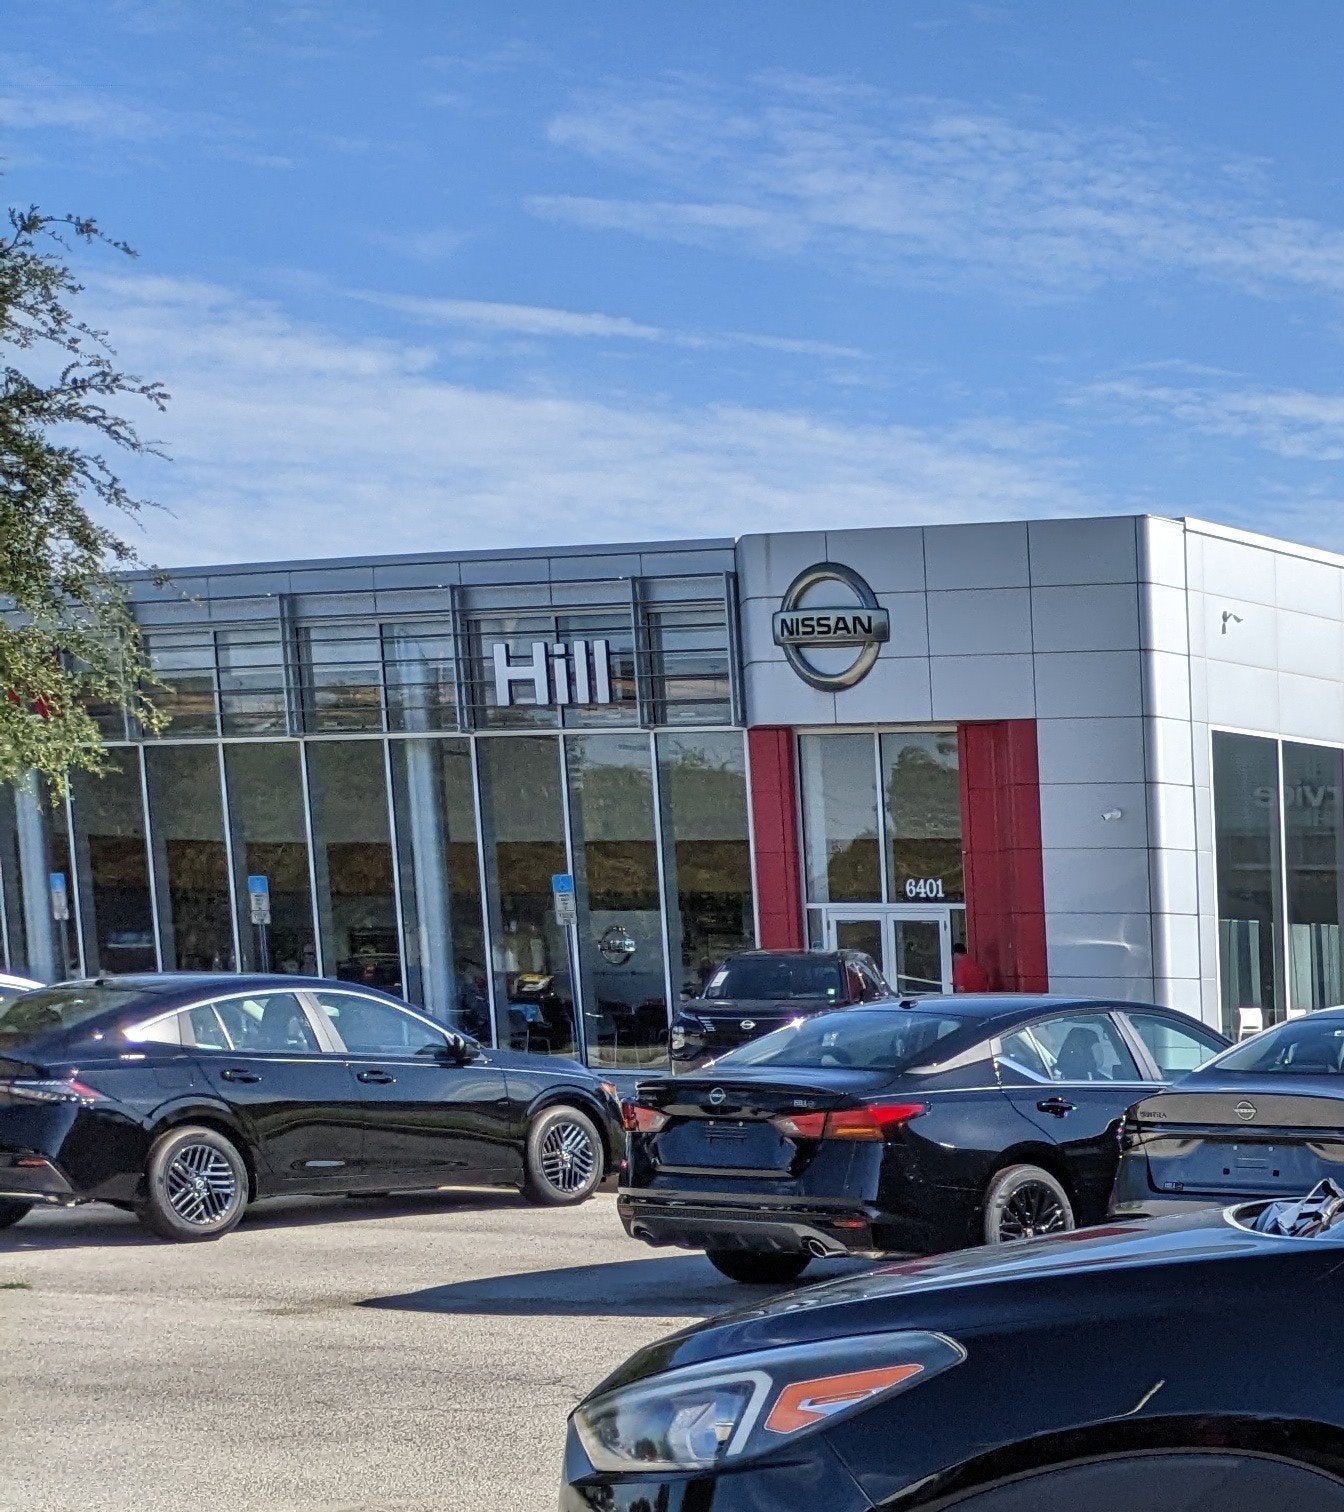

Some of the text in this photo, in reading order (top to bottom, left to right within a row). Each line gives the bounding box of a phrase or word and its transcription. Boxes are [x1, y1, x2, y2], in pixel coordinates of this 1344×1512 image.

[780, 616, 873, 637] NISSAN
[493, 640, 612, 706] Hill
[905, 878, 945, 898] 6401
